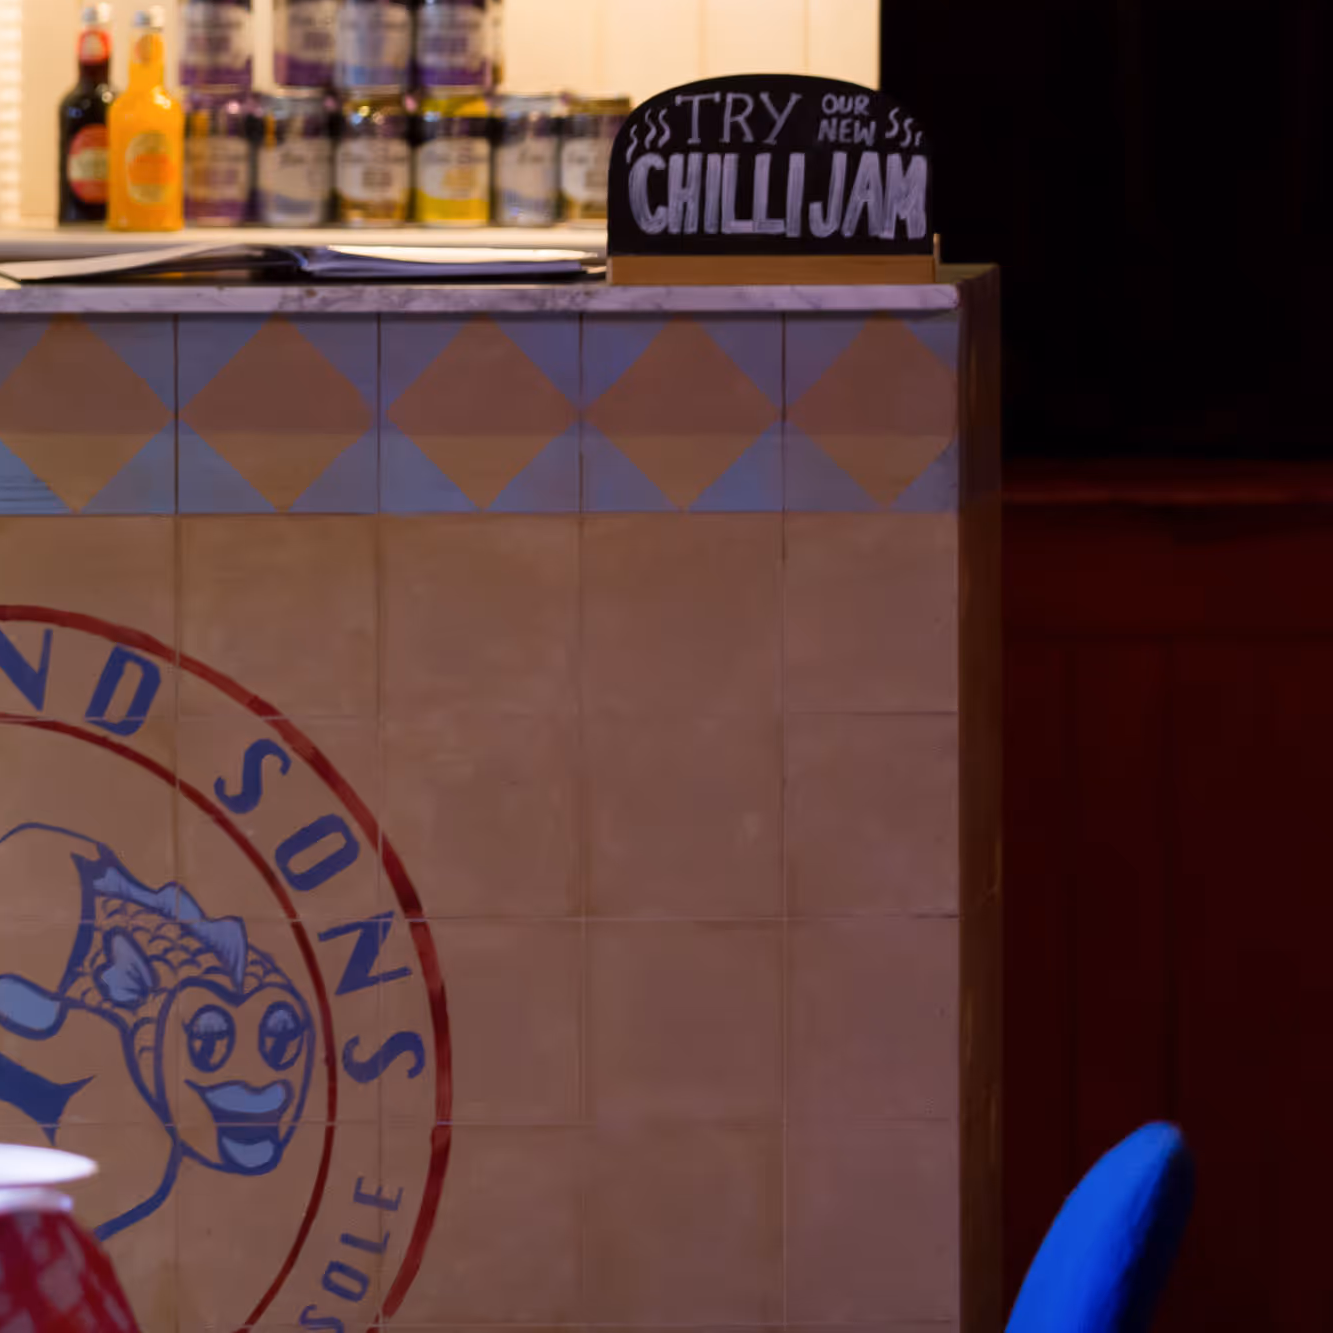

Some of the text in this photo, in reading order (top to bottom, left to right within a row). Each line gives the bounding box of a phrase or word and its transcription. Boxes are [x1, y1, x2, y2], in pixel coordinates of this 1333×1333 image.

[674, 91, 803, 146] TRY
[818, 119, 877, 147] NEW
[821, 93, 870, 115] OUR
[628, 151, 928, 240] CHILLI JAM
[213, 738, 425, 1084] SONS
[298, 1175, 404, 1333] SOLE
